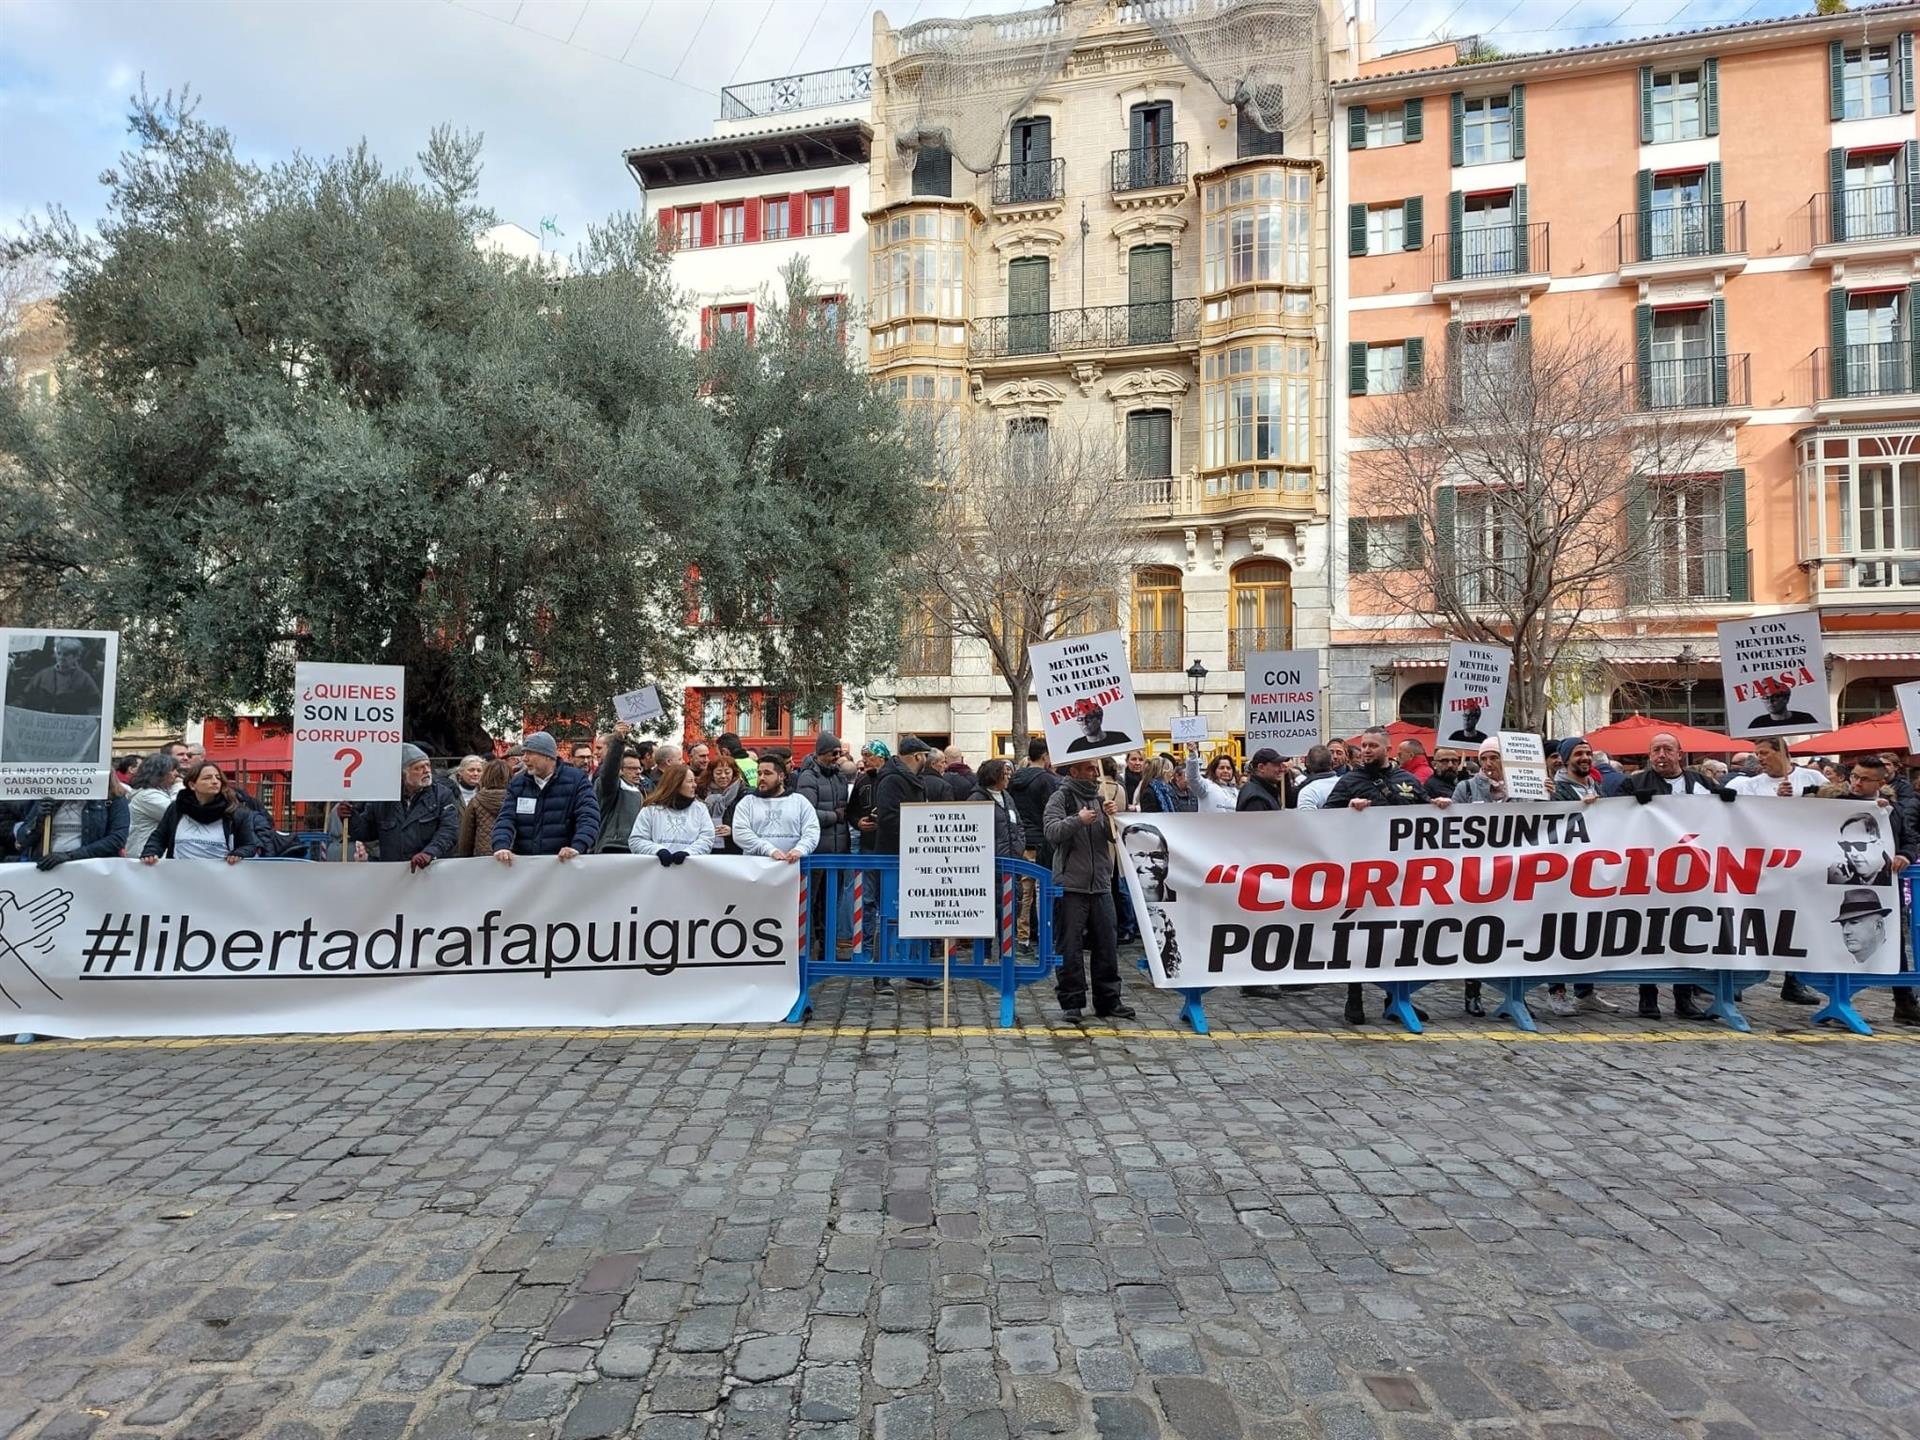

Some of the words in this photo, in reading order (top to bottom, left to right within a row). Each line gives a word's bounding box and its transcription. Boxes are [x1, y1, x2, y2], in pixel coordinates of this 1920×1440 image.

[1749, 626, 1758, 635] Y
[1761, 622, 1787, 634] CON
[1735, 633, 1805, 649] MENTIRAS,
[1062, 642, 1090, 655] 1000
[1736, 645, 1807, 661] INOCENTES
[1048, 651, 1109, 671] MENTIRAS
[1468, 650, 1493, 661] VIVAS:
[1459, 660, 1499, 672] MENTIRAS
[1740, 664, 1748, 673] A
[1752, 658, 1806, 672] PRISIÓN
[1050, 672, 1068, 683] NO
[1071, 663, 1110, 680] HACEN
[1264, 670, 1300, 686] CON
[1453, 670, 1458, 679] A
[1460, 671, 1490, 683] CAMBIO
[1492, 676, 1502, 684] DE
[1046, 684, 1071, 697] UNA
[1074, 675, 1121, 692] VERDAD
[1464, 683, 1488, 693] VOTOS
[1733, 667, 1816, 703] FALSA
[303, 683, 397, 701] ¿QUIENES
[1250, 691, 1314, 705] MENTIRAS
[304, 705, 347, 721] SON
[354, 706, 395, 723] LOS
[1250, 709, 1315, 725] FAMILIAS
[296, 729, 401, 744] CORRUPTOS
[1248, 728, 1318, 740] DESTROZADAS
[1, 767, 12, 775] EL
[16, 767, 60, 776] INJUSTO
[62, 767, 98, 776] DOLOR
[334, 748, 364, 789] ?
[3, 776, 54, 785] CAUSADO
[56, 777, 78, 785] NOS
[80, 777, 94, 785] LA
[6, 787, 21, 795] HA
[22, 787, 91, 795] ARREBATADO
[948, 812, 967, 821] ERA
[916, 824, 930, 834] EL
[932, 823, 979, 834] ALCALDE
[1388, 811, 1592, 852] PRESUNTA
[918, 835, 936, 844] CON
[938, 836, 952, 844] UN
[953, 834, 977, 844] CASO
[908, 846, 921, 855] DE
[922, 844, 986, 854] CORRUPCIÓN”
[944, 855, 951, 864] Y
[935, 864, 980, 875] CONVERTÍ
[1204, 833, 1803, 912] “CORRUPCIÓN”
[941, 876, 953, 885] EN
[907, 887, 987, 898] COLABORADOR
[934, 899, 946, 908] DE
[949, 899, 960, 908] LA
[909, 908, 985, 919] INVESTIGACIÓN”
[82, 904, 785, 979] #libertadrafapuigrós
[1207, 906, 1808, 973] POLÍTICO-JUDICIAL
